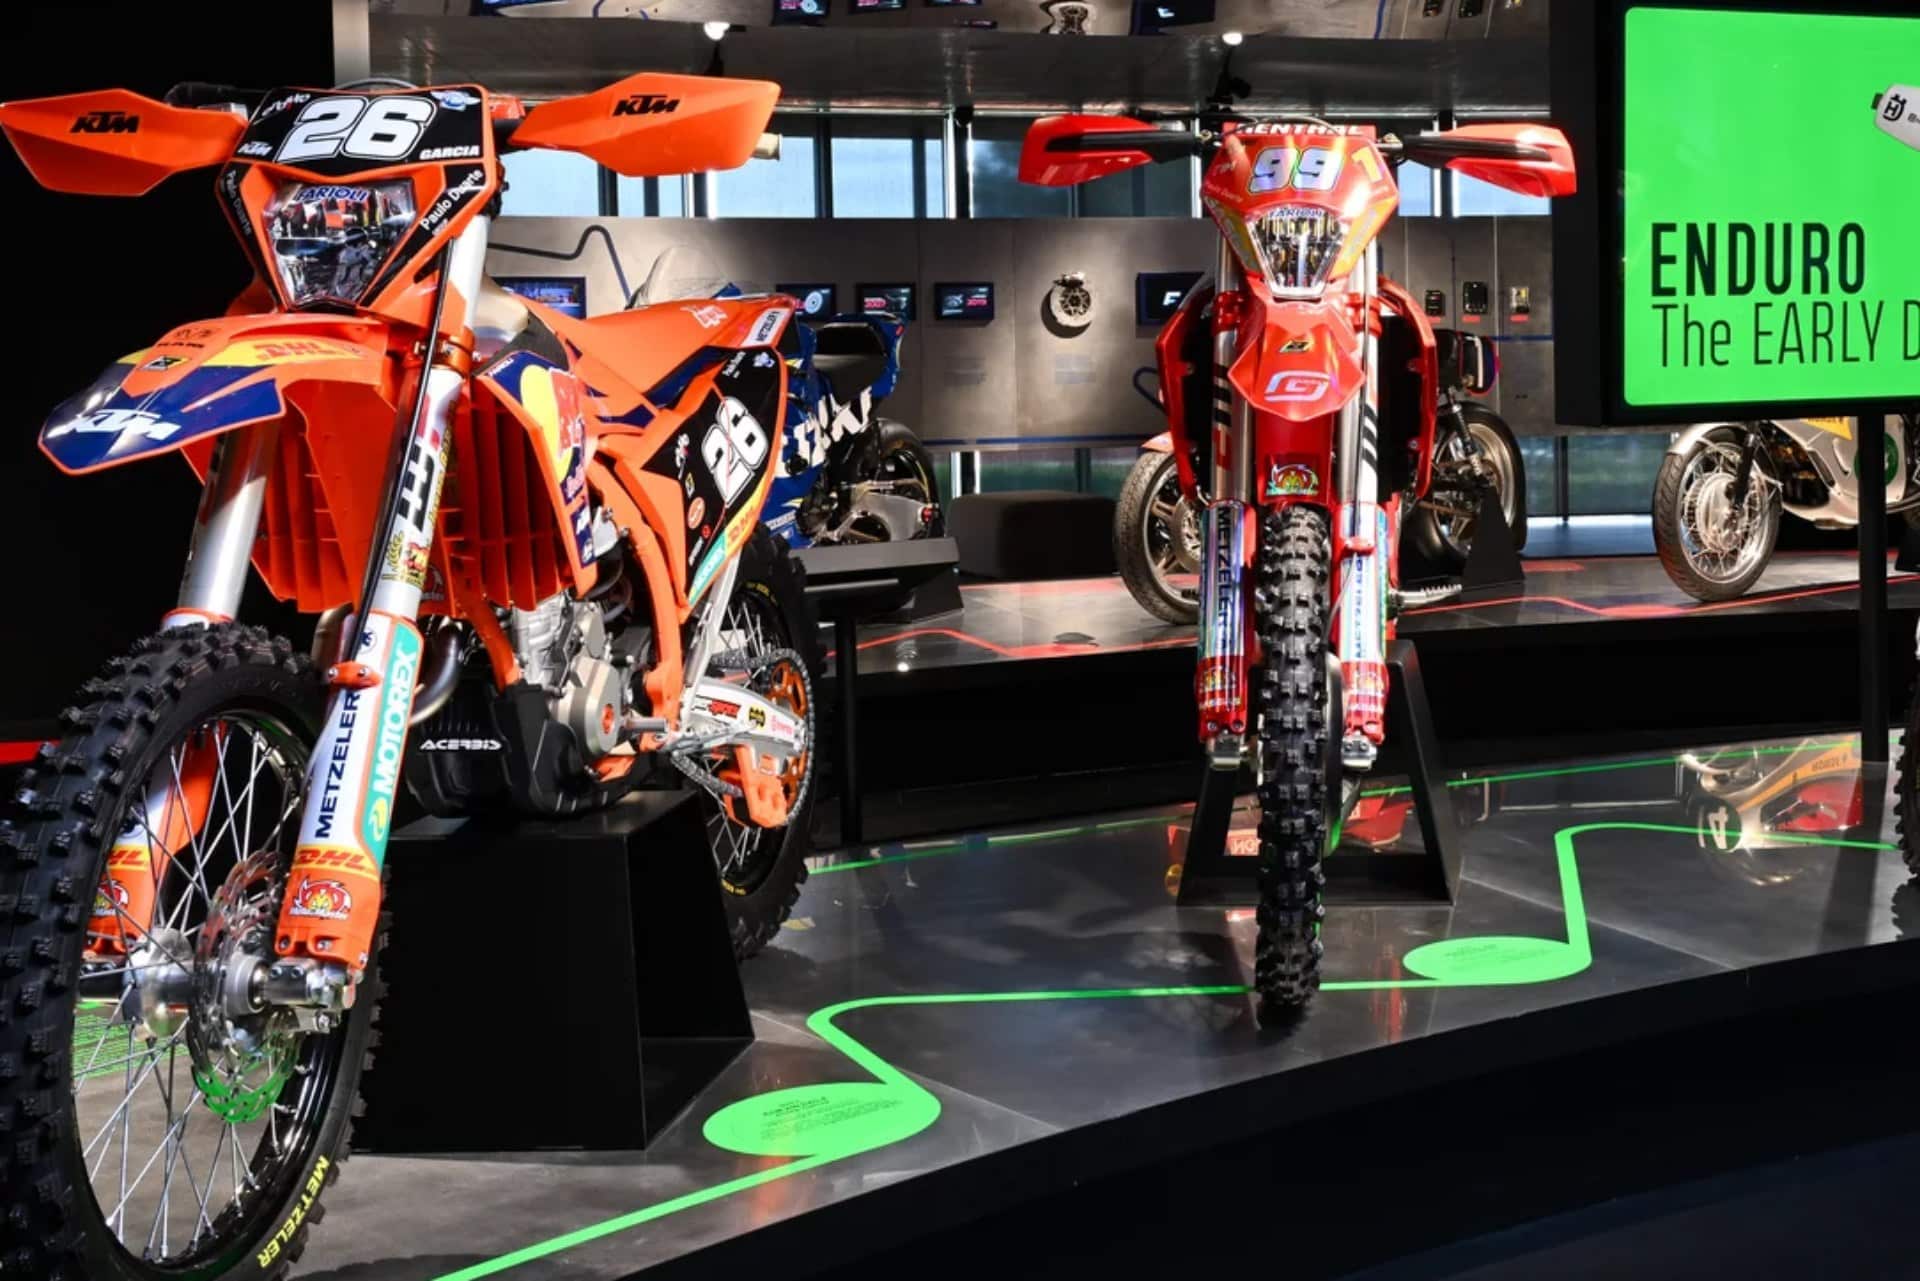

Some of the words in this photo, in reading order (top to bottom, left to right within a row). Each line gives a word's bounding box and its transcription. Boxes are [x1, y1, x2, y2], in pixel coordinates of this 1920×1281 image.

[70, 111, 140, 133] KTM
[274, 95, 438, 163] 26
[612, 94, 681, 116] KTM
[237, 141, 273, 156] KTM
[419, 145, 480, 161] GARCIA
[1248, 147, 1346, 194] 99
[420, 199, 453, 231] Paulo
[447, 169, 484, 202] Duarte
[1651, 222, 1866, 297] ENDURO
[1651, 303, 1732, 368] The
[1753, 300, 1885, 365] EARLY
[701, 395, 769, 509] 26
[378, 649, 417, 796] MOTOREX
[419, 739, 502, 752] ACERBIS
[314, 692, 362, 839] METZELER
[106, 849, 144, 866] HL
[298, 849, 366, 870] DHL
[255, 1152, 331, 1270] METZELER
